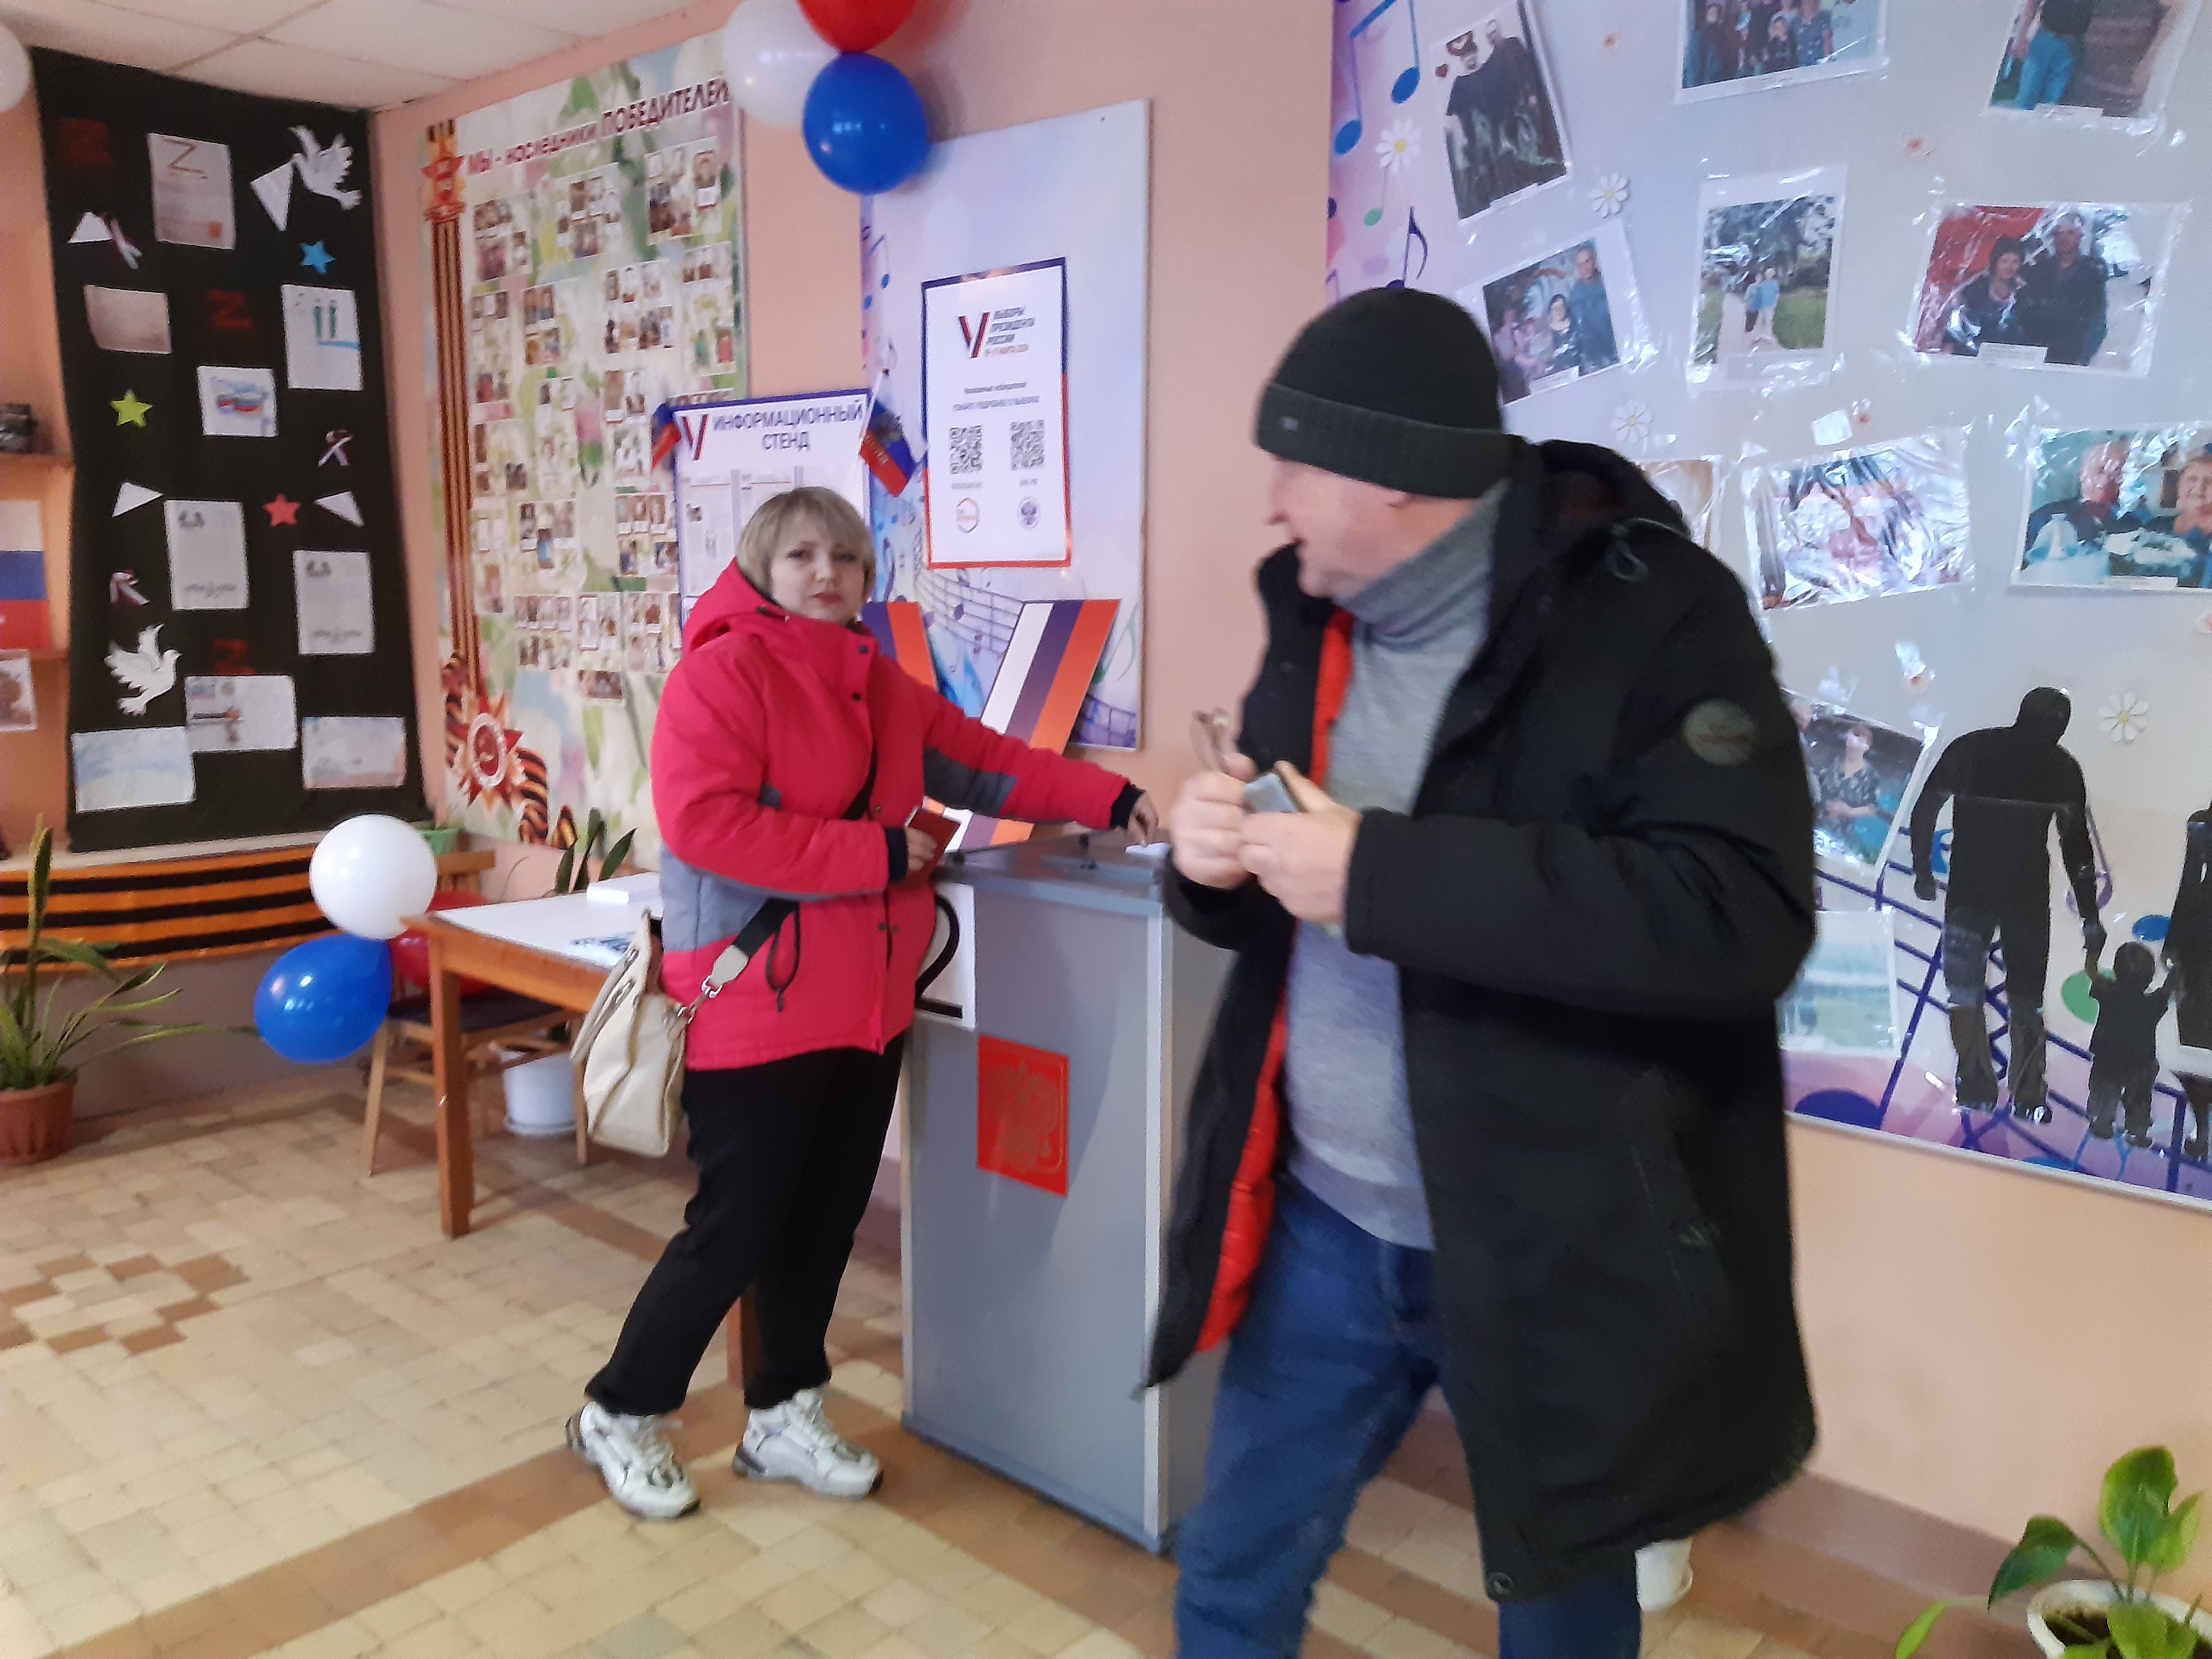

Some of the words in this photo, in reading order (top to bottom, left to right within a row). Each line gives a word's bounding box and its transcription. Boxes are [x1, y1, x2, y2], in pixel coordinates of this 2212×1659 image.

[601, 71, 729, 135] ПОБЕДИТЕЛЕЙ
[713, 400, 864, 431] ИНФОРМАЦИОННЫЙ
[762, 432, 810, 451] СТЕНД
